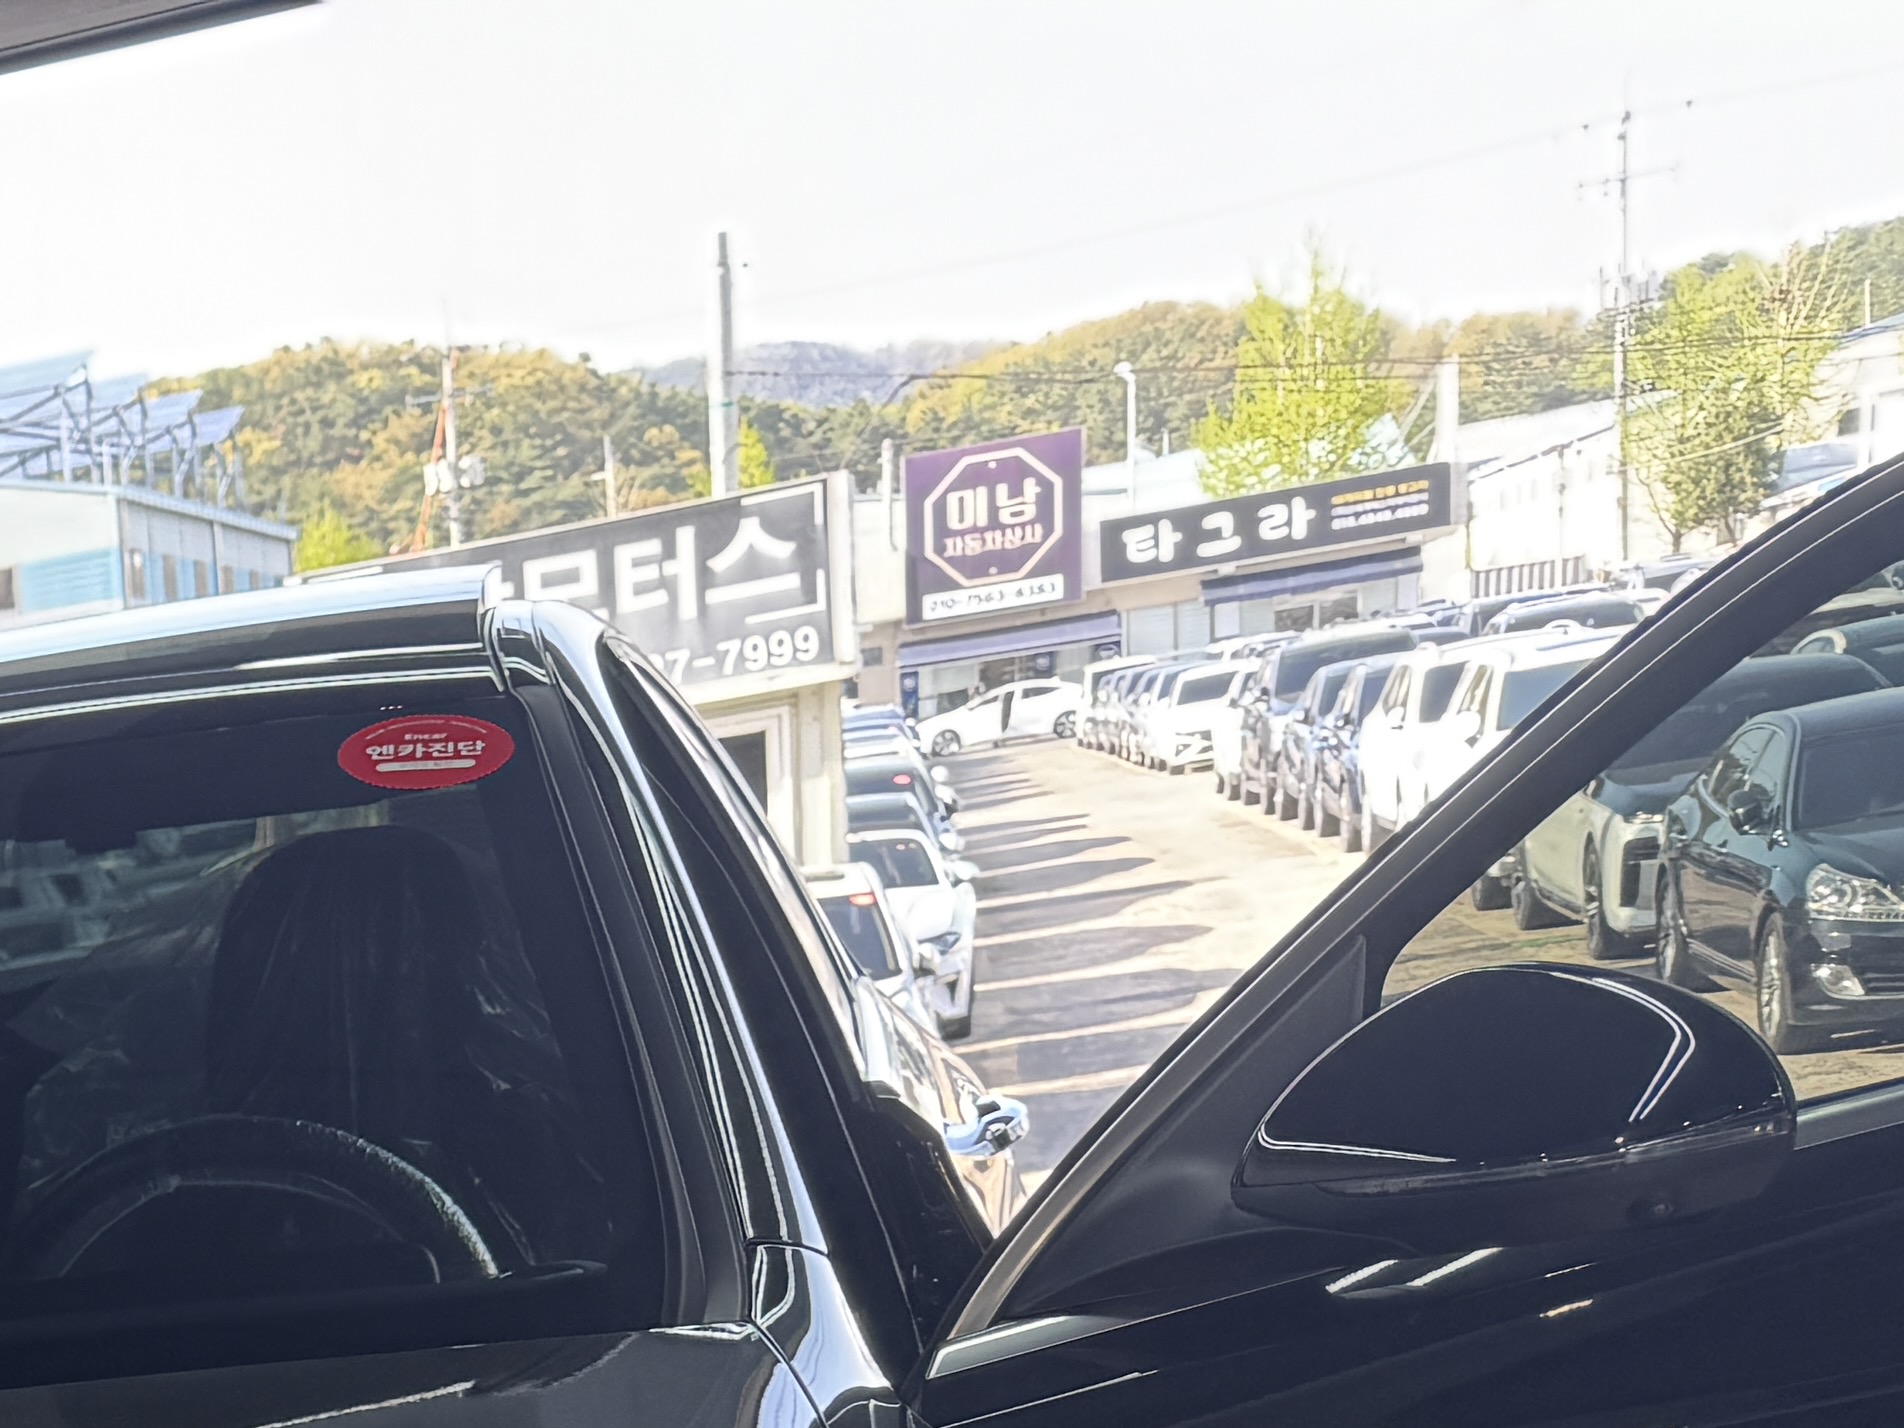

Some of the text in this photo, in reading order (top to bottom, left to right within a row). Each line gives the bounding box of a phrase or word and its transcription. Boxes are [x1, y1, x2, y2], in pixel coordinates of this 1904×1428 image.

[1121, 496, 1317, 563] 타그라
[485, 515, 803, 621] 모터스
[365, 740, 487, 761] 엔카진단
